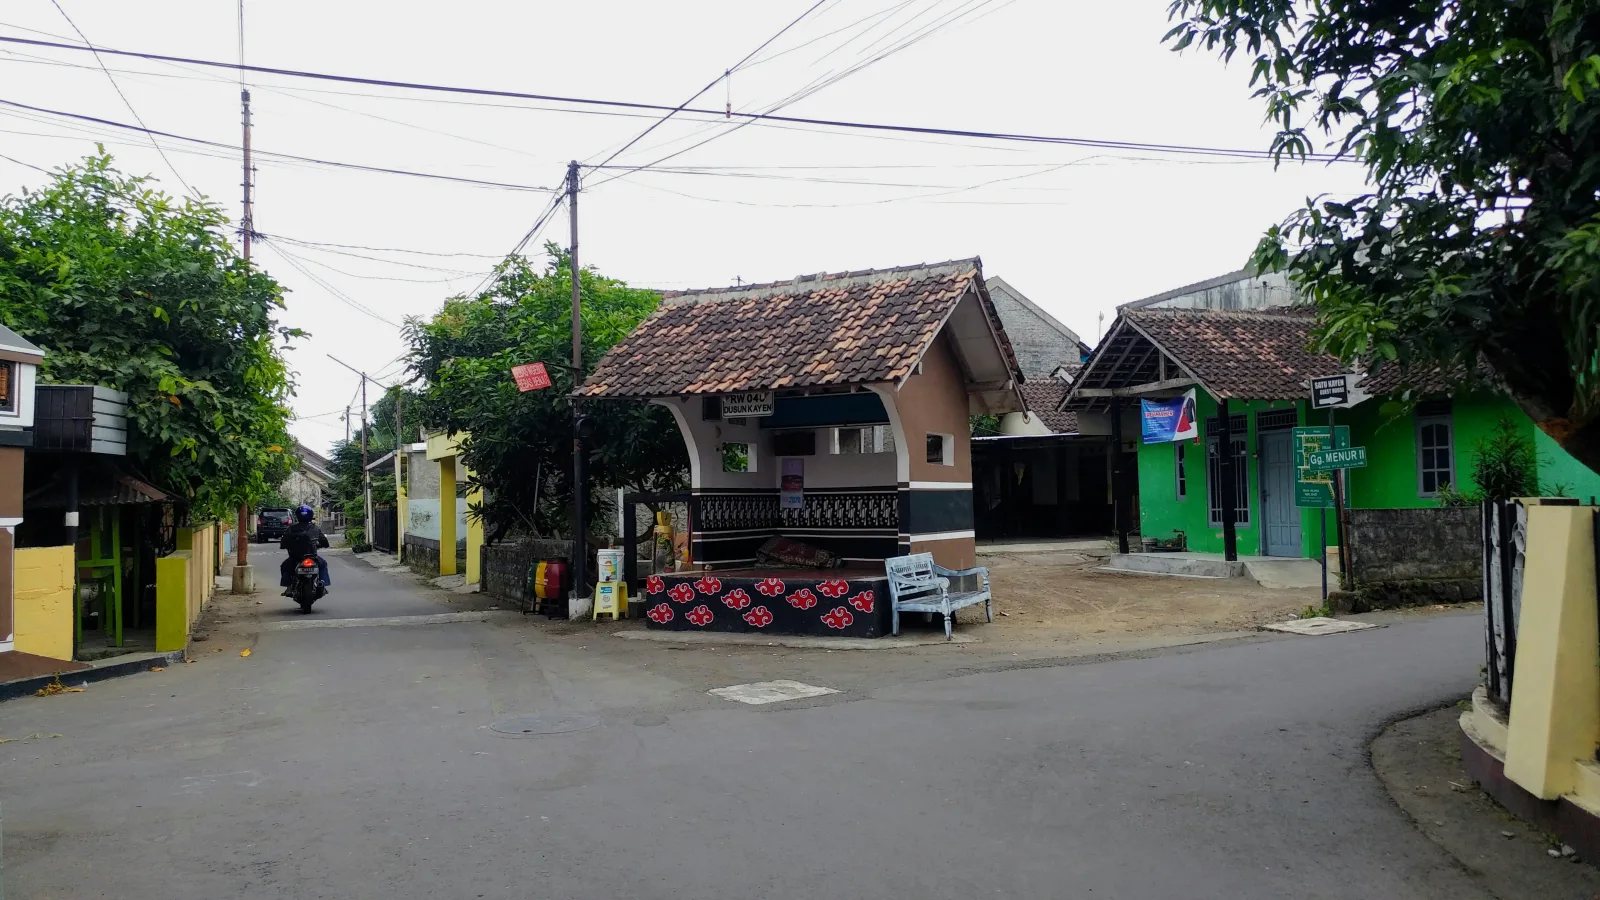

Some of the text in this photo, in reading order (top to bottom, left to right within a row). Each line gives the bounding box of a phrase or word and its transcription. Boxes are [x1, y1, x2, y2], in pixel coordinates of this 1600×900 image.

[1314, 378, 1344, 390] SATU KAYEN
[730, 394, 746, 404] RW
[724, 404, 772, 414] DUSUN KAYEN
[1310, 454, 1324, 466] Gg.
[1326, 450, 1358, 462] MENUR
[1359, 450, 1364, 460] II
